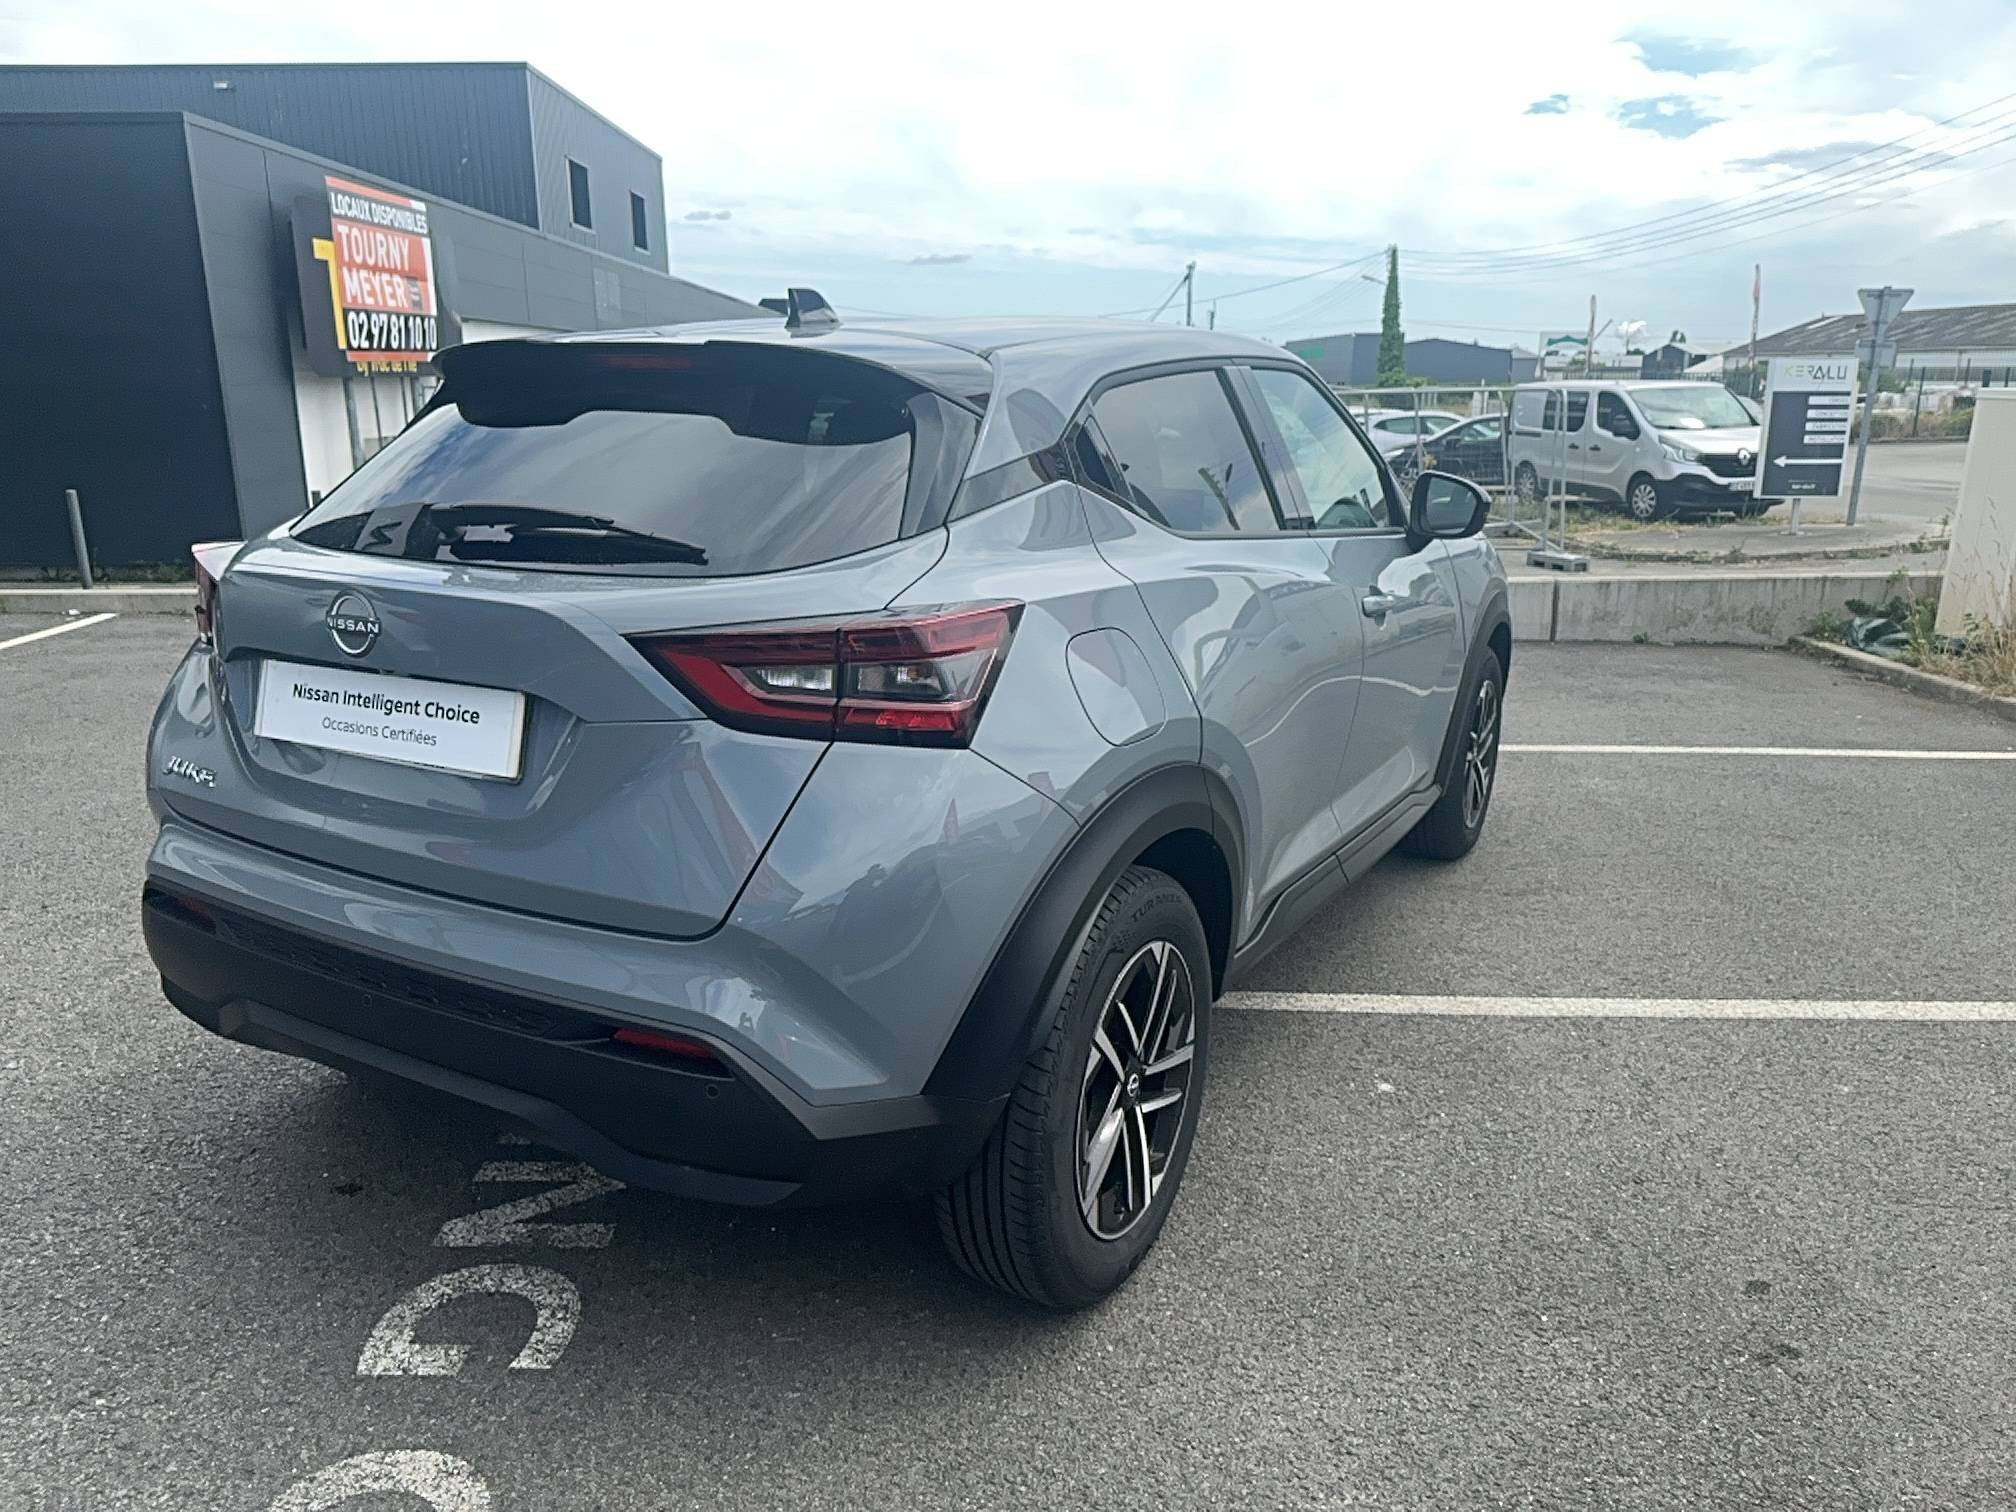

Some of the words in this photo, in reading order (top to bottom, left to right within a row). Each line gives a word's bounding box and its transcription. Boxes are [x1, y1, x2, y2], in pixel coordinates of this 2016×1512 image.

[330, 191, 371, 222] LOCAUX
[373, 204, 428, 234] DISPONIBLES
[336, 224, 411, 271] TOURNY
[341, 268, 410, 308] MEYER
[346, 311, 370, 349] 02
[371, 313, 389, 350] 97
[390, 315, 406, 350] 81
[408, 316, 422, 350] 10
[424, 317, 438, 350] 10
[326, 616, 380, 633] NISSAN
[292, 682, 340, 705] Nissan
[343, 690, 421, 717] Intelligent
[424, 701, 481, 724] Choice
[322, 715, 379, 739] Occasions
[381, 723, 438, 747] Certifiées
